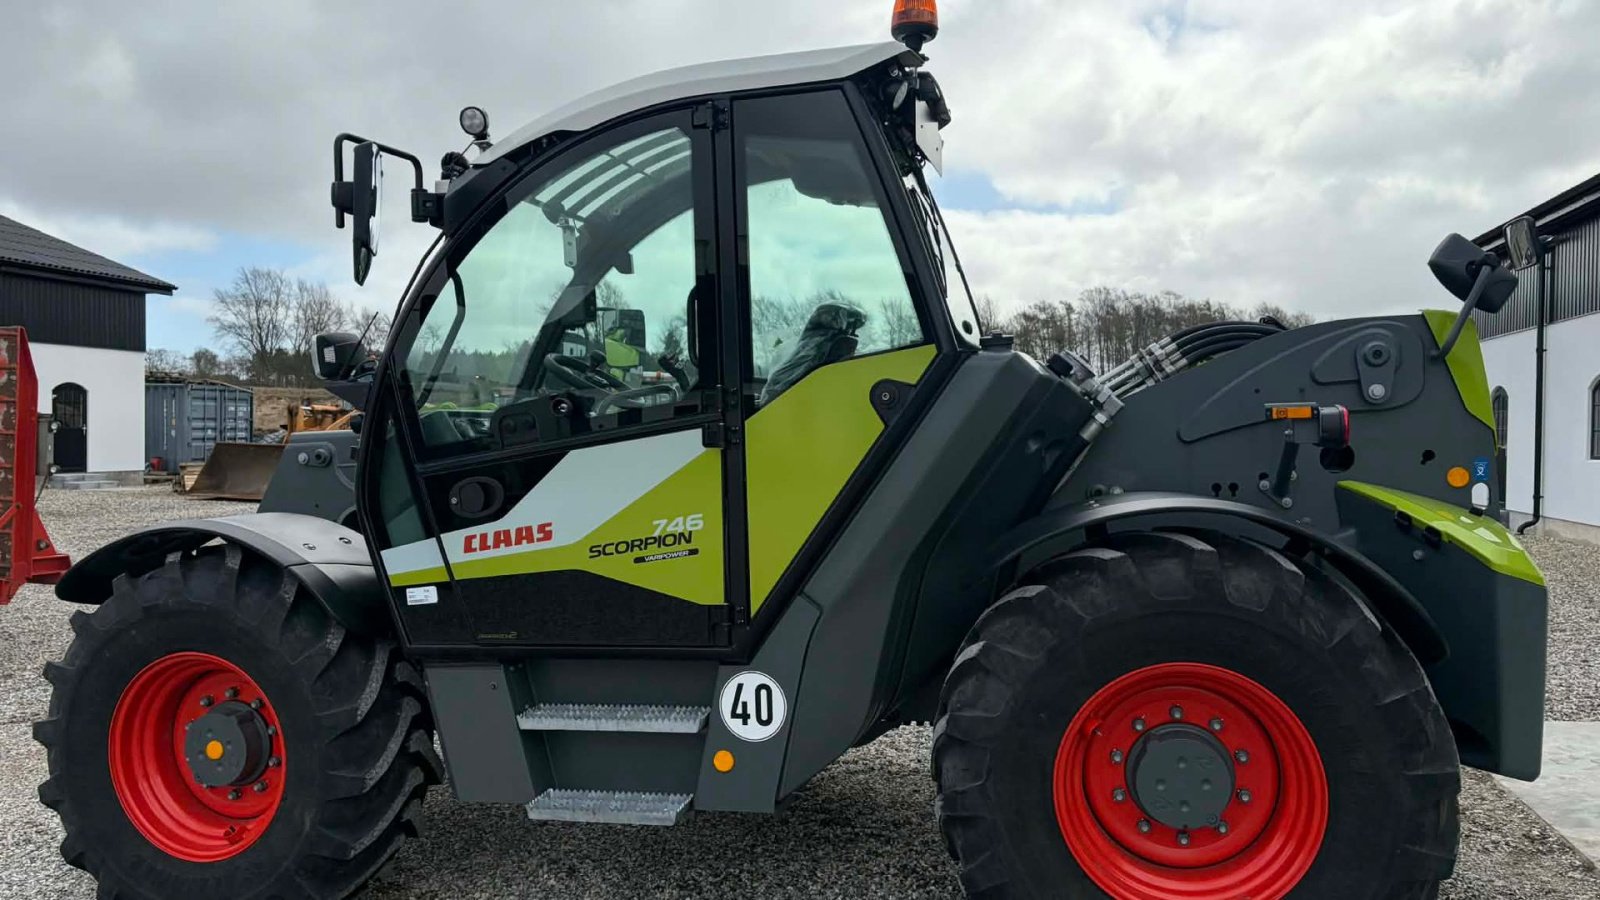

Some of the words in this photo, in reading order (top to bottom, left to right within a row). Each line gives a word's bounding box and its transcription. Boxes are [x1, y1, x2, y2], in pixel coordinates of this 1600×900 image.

[464, 522, 553, 554] CLAAS
[652, 513, 704, 536] 746
[588, 530, 693, 559] SCORPION
[644, 550, 689, 562] VARIPOWER
[730, 682, 774, 727] 40
